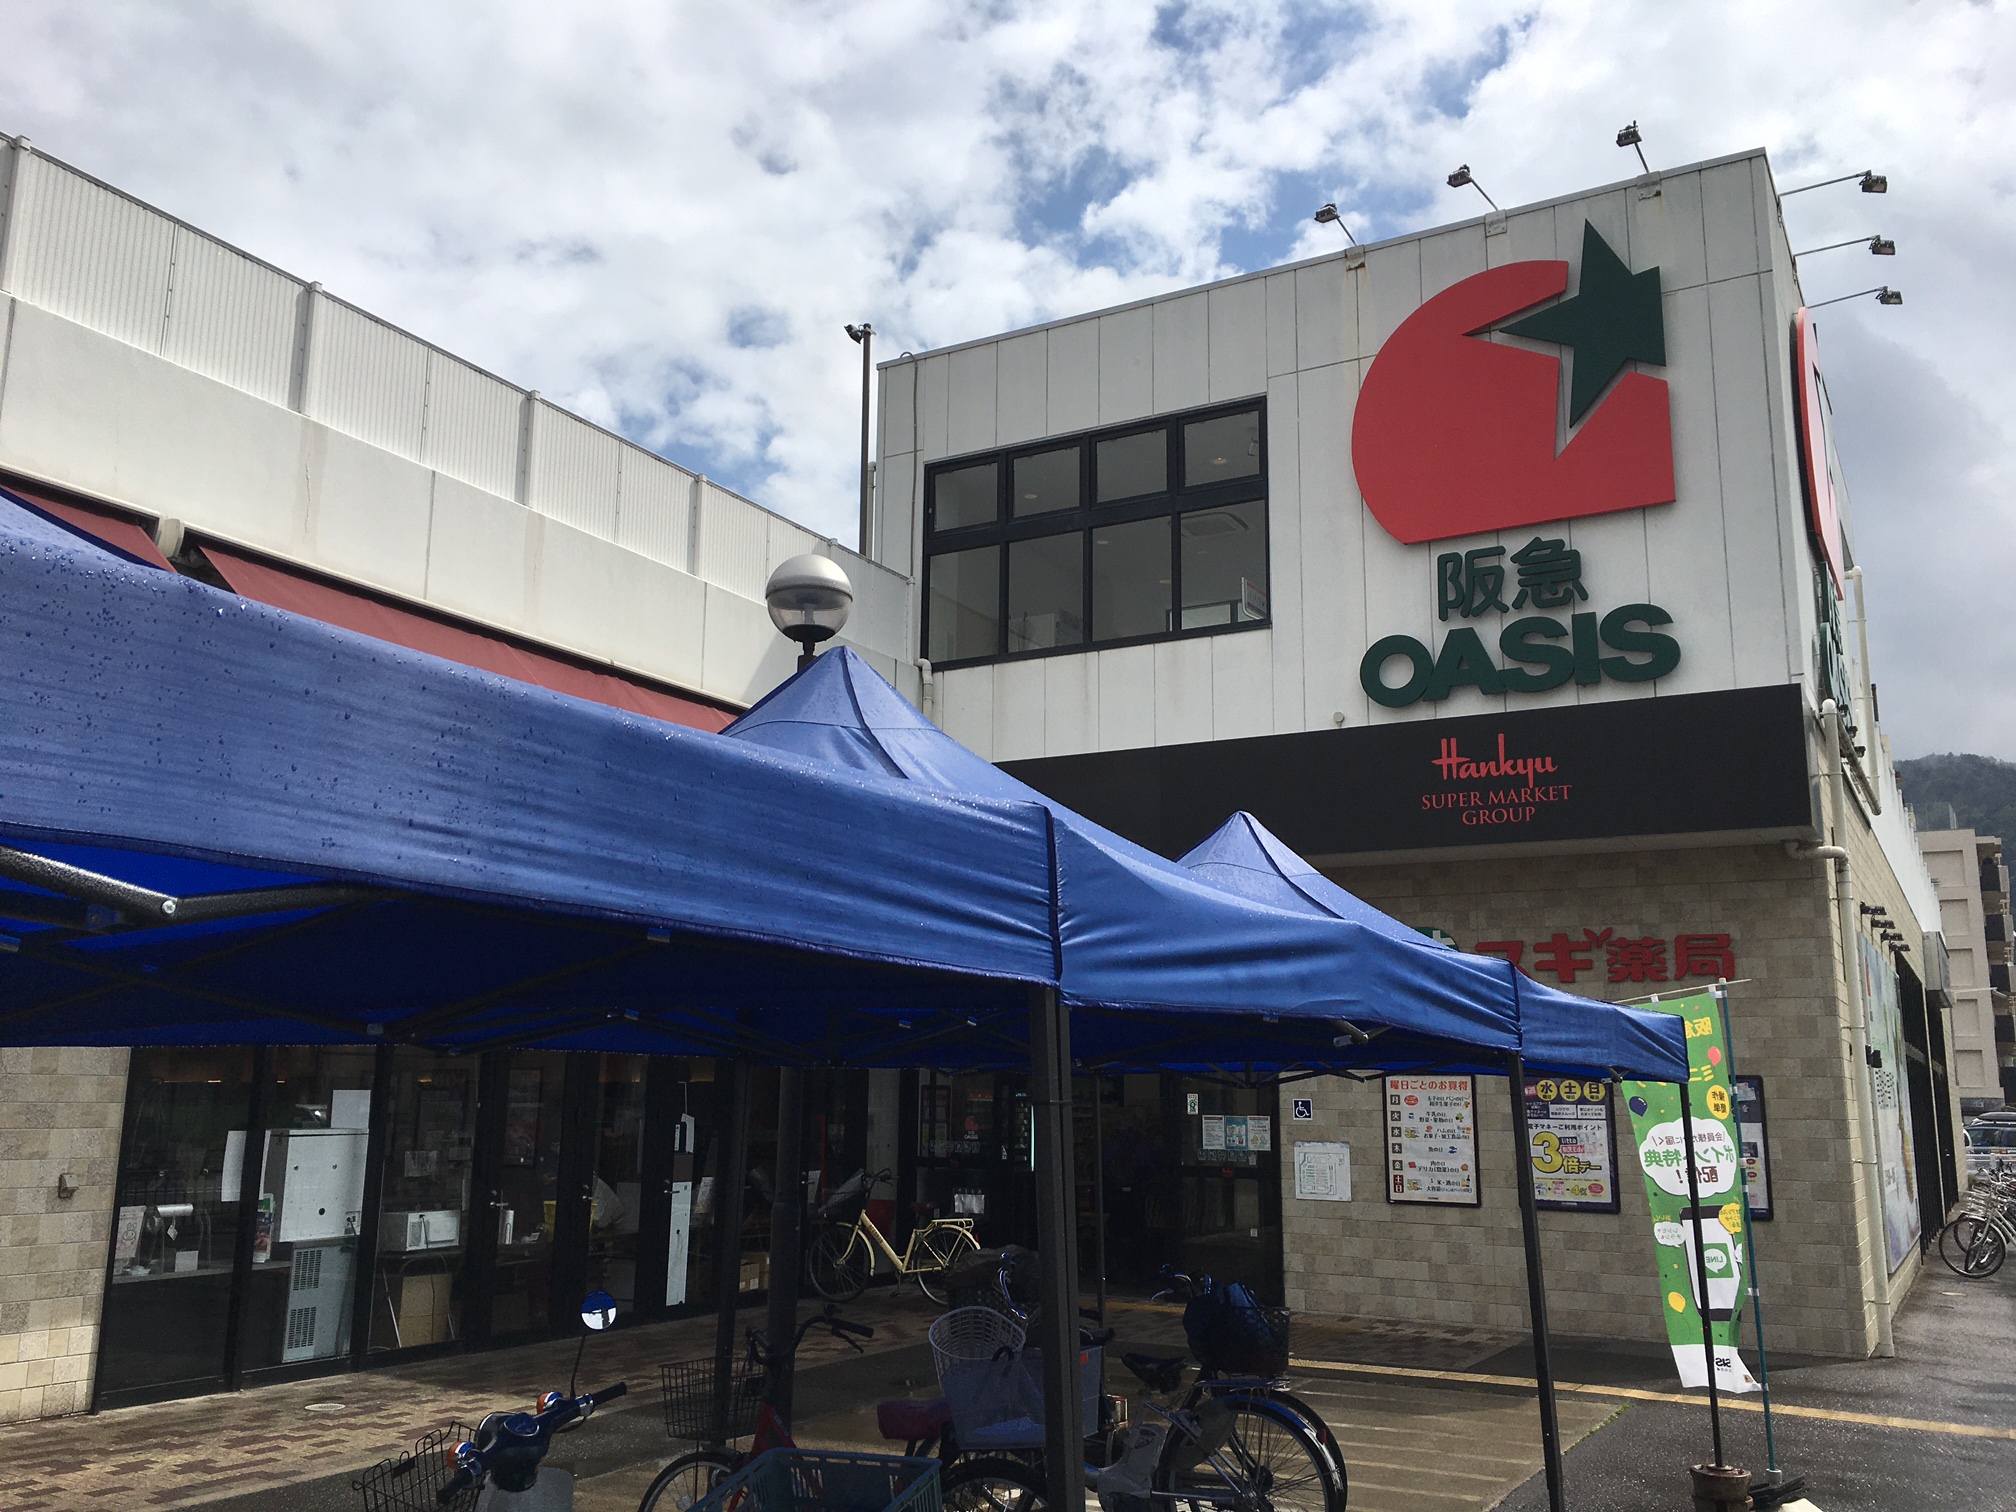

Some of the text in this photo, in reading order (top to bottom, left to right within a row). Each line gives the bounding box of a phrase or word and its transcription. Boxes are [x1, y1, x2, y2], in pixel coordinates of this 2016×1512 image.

[1437, 537, 1589, 622] 阪急
[1360, 603, 1682, 708] OASIS
[1431, 733, 1559, 788] Hankyu
[1421, 783, 1573, 811] SUPER MARKET
[1461, 806, 1536, 826] GROUP
[1390, 1080, 1469, 1091] 曜日ごとのお買得
[1541, 1082, 1554, 1094] 水
[1564, 1082, 1577, 1095] 土
[1589, 1083, 1600, 1095] 日
